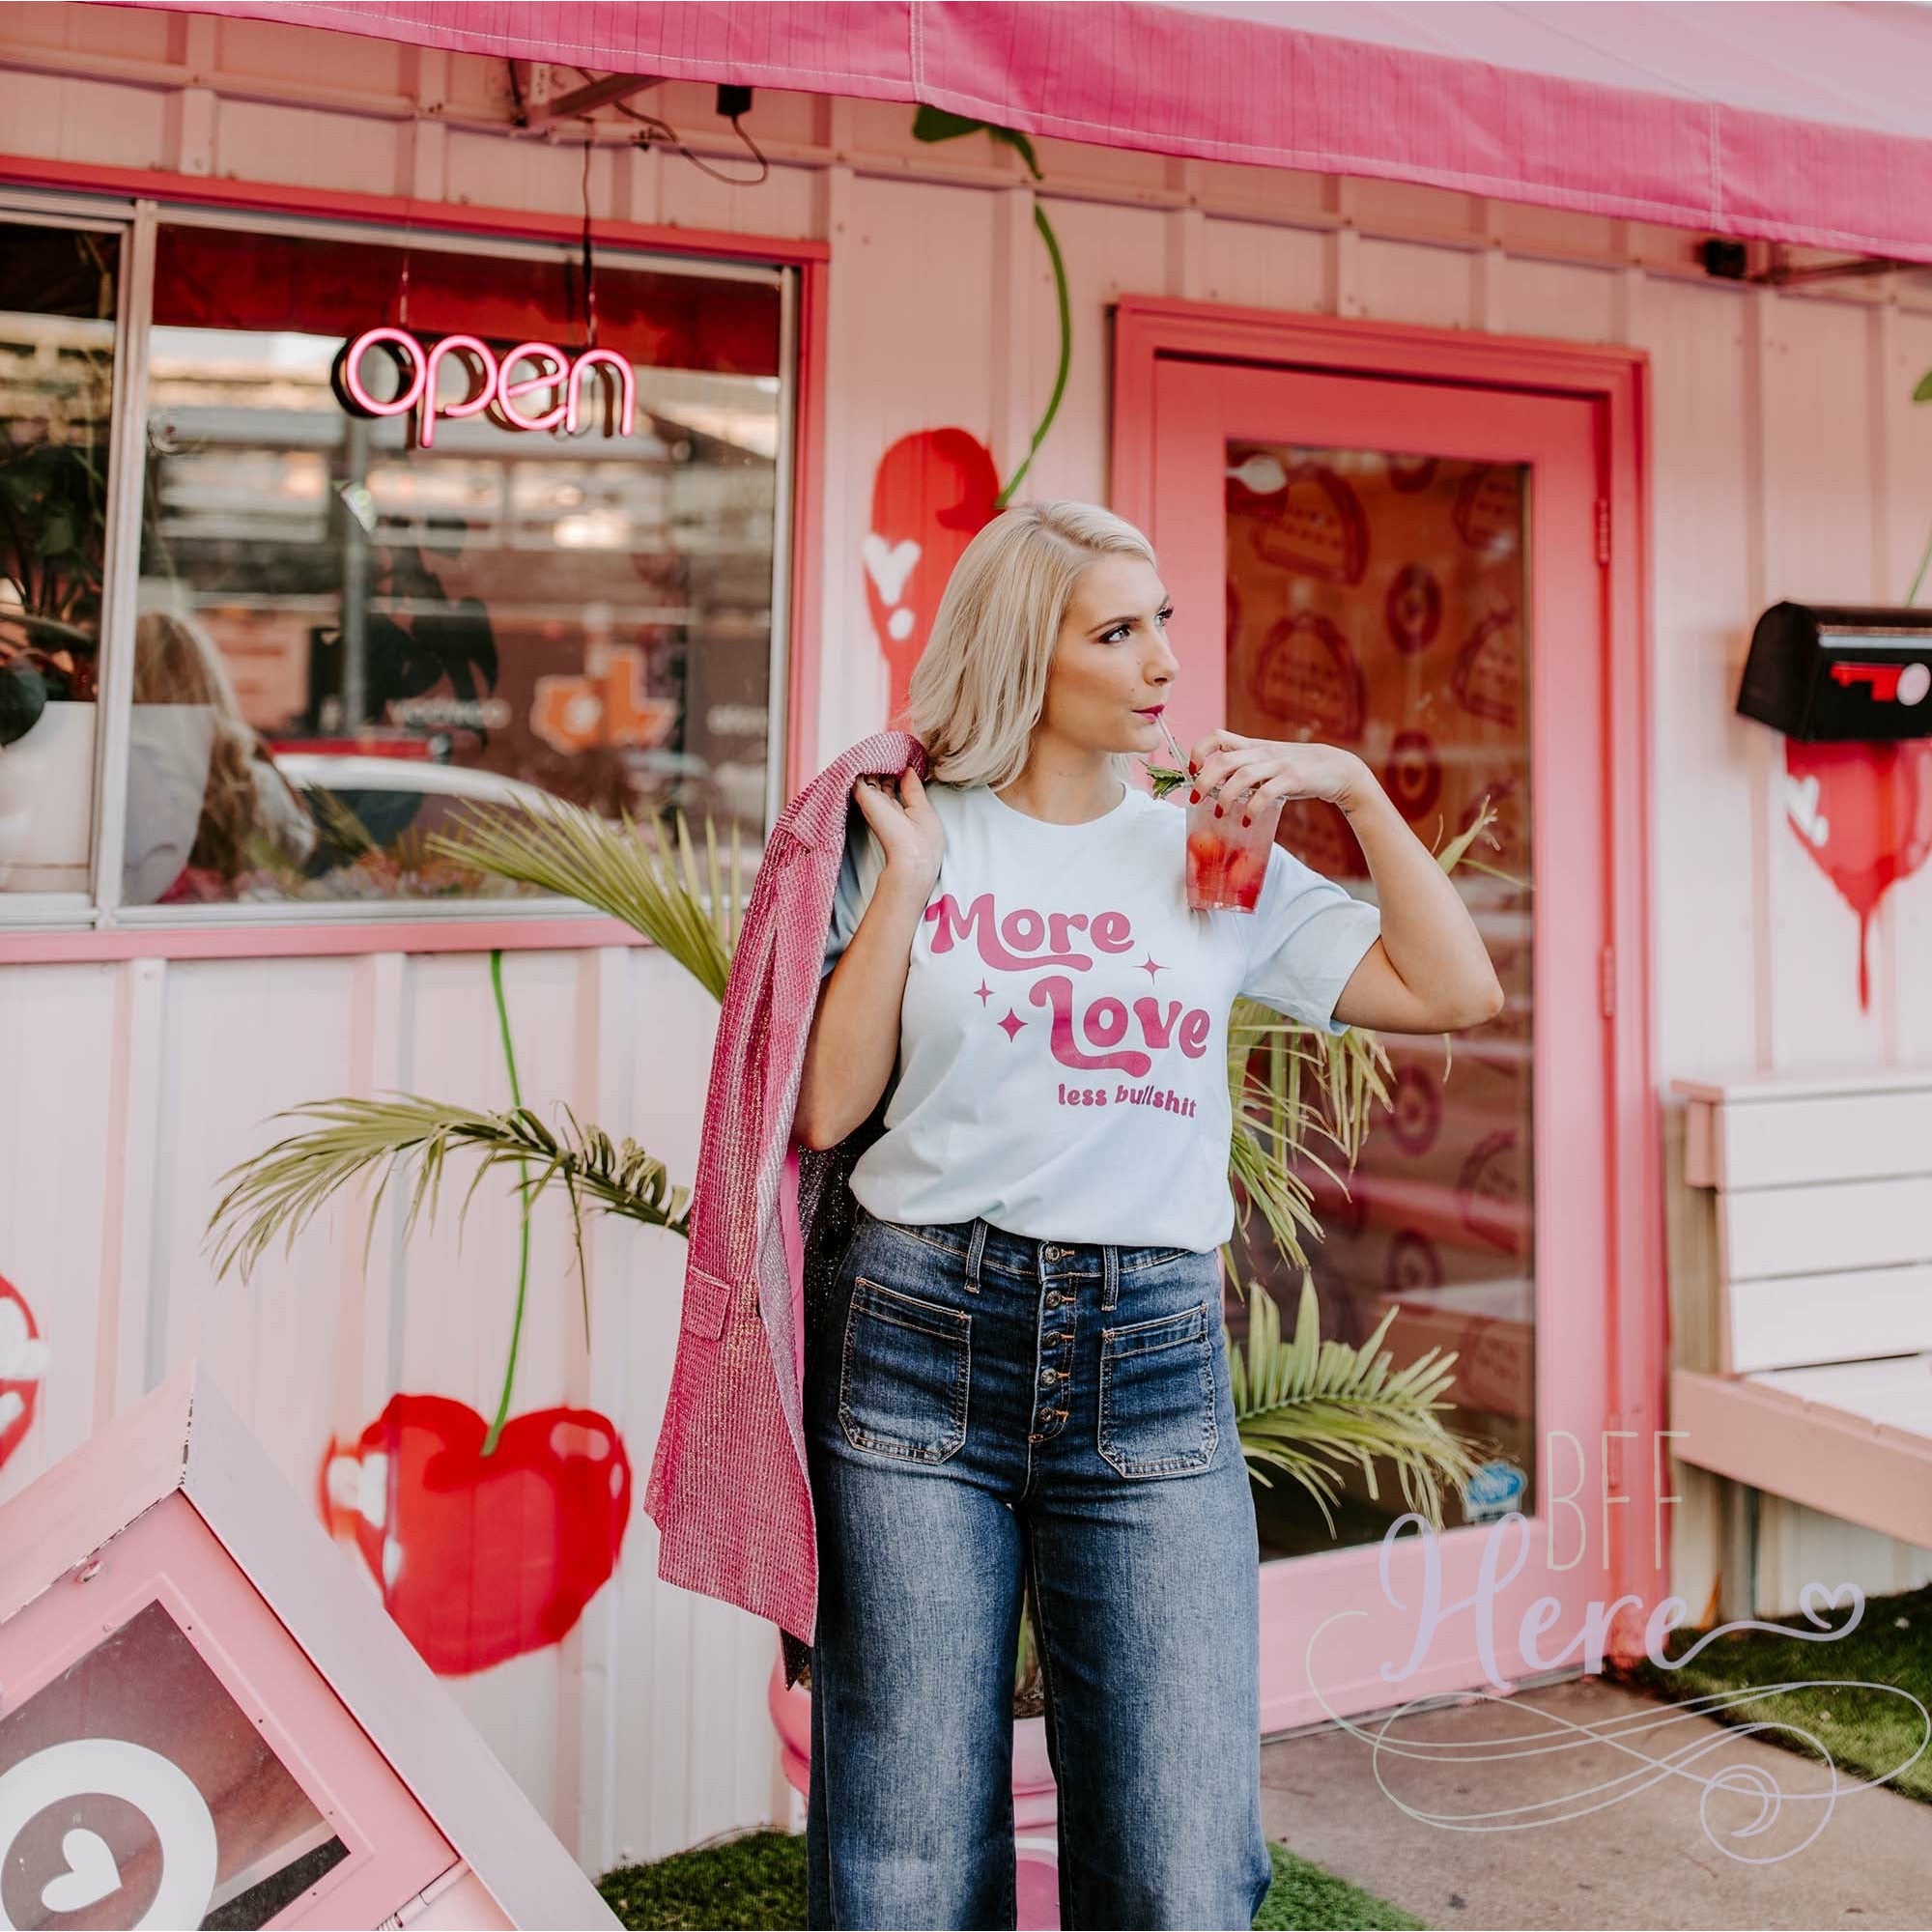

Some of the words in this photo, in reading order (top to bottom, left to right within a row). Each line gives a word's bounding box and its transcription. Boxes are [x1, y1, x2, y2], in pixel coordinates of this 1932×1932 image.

[345, 327, 636, 448] open
[924, 893, 1135, 972] More
[1029, 975, 1210, 1078] Love
[1058, 1083, 1107, 1106] less
[1114, 1084, 1197, 1119] bullshit
